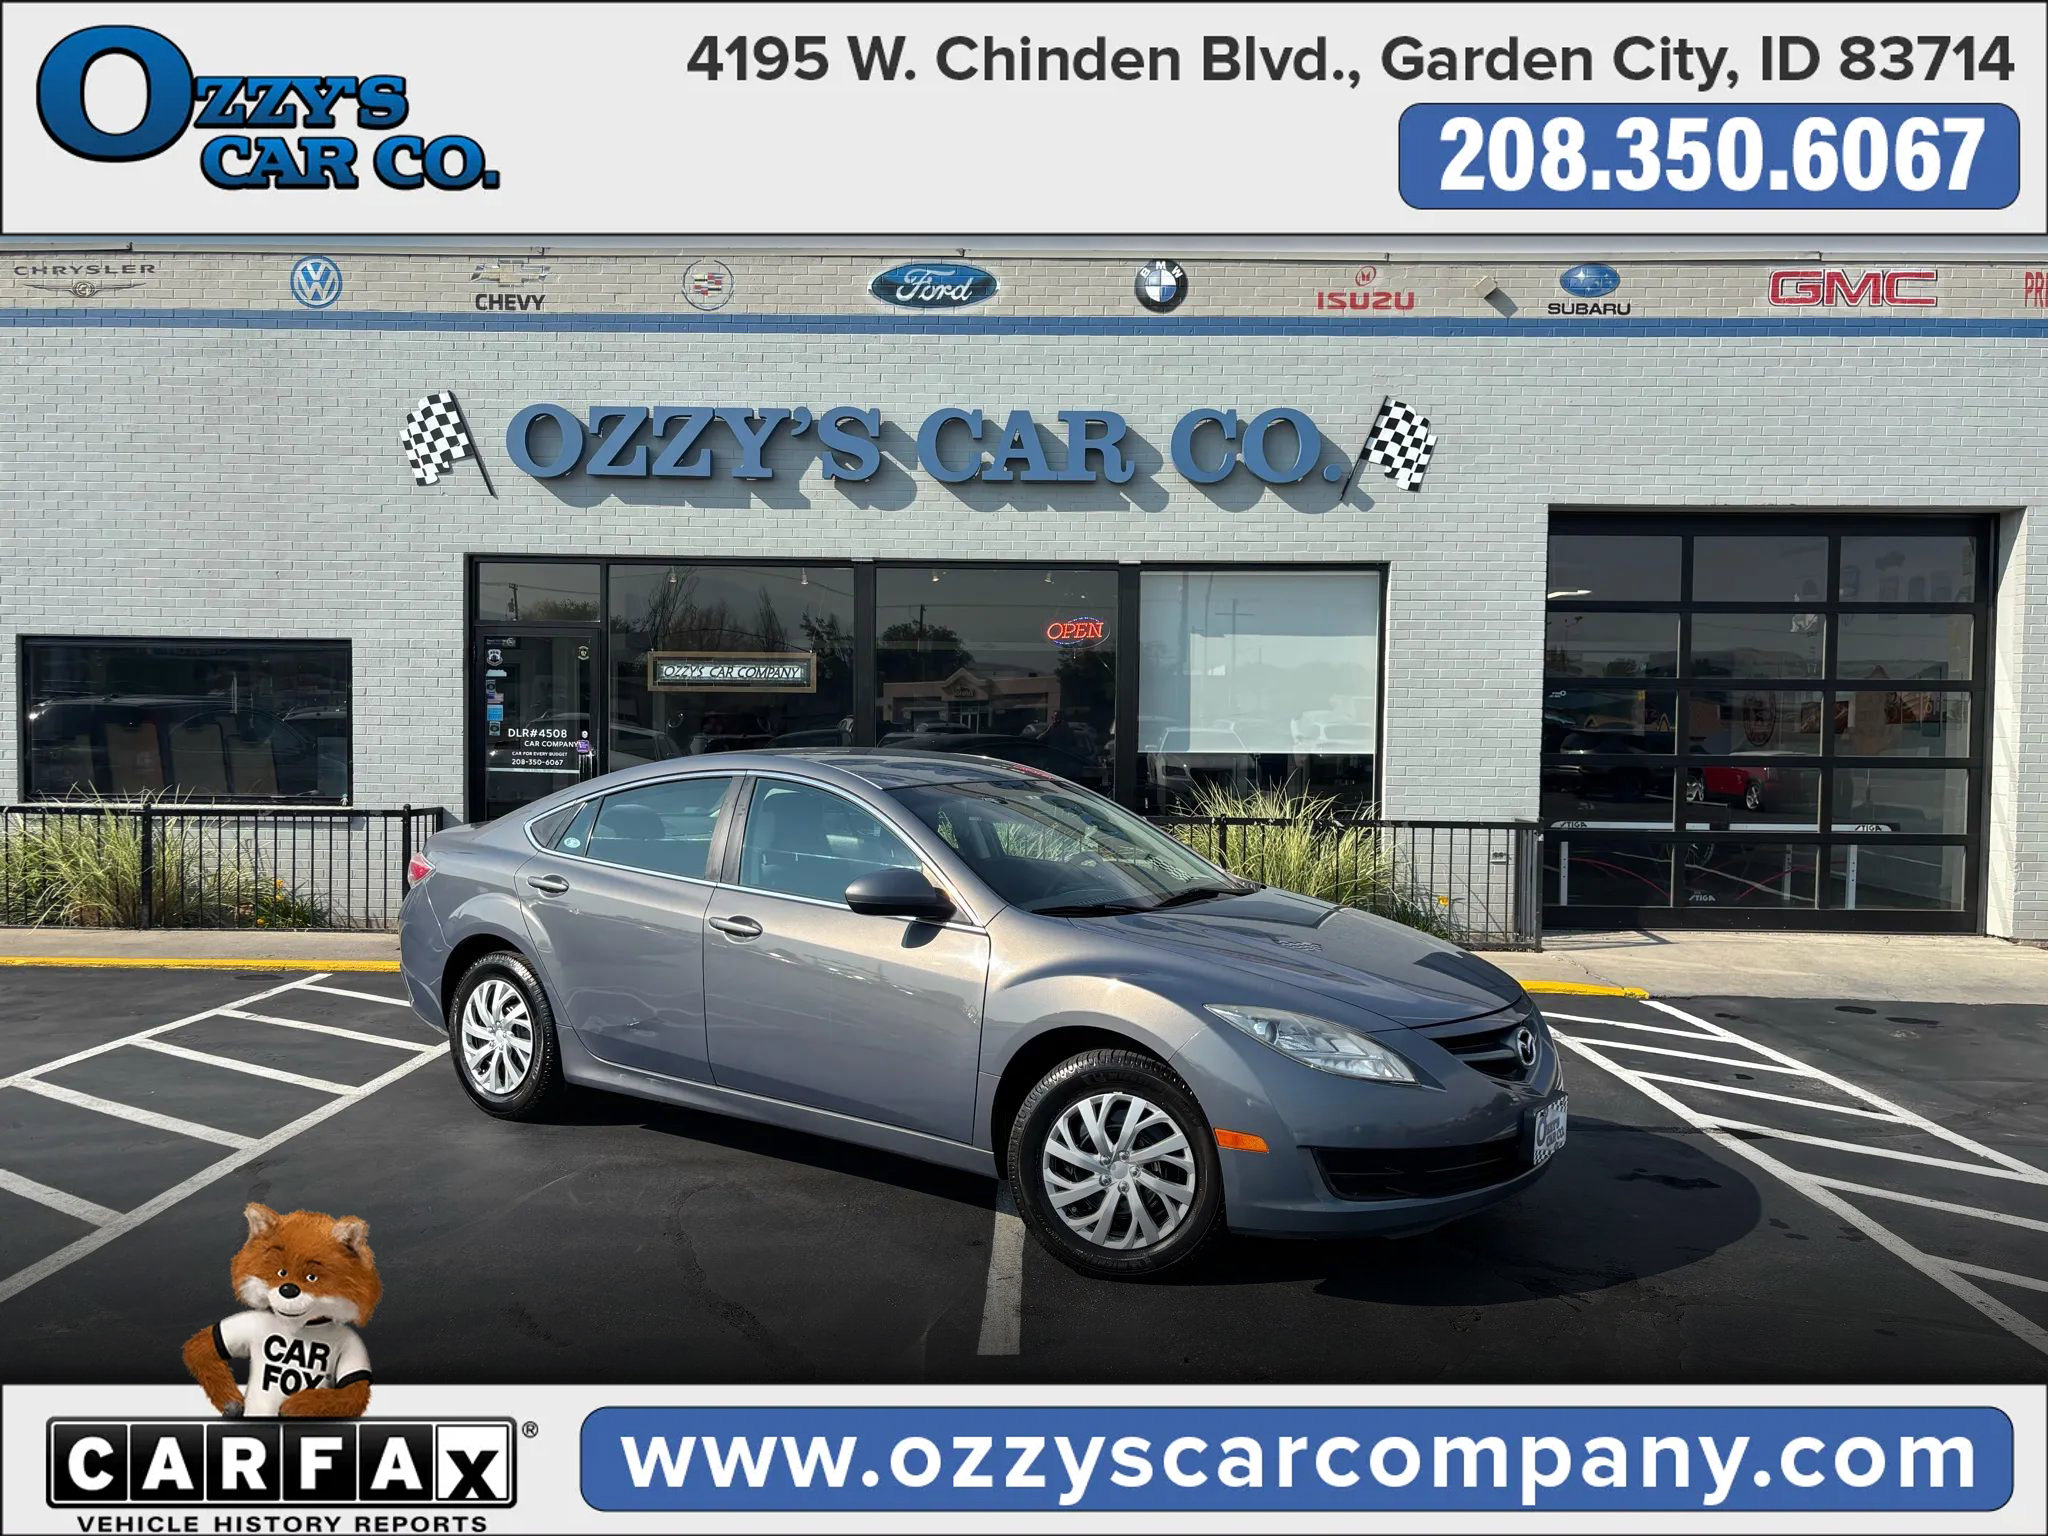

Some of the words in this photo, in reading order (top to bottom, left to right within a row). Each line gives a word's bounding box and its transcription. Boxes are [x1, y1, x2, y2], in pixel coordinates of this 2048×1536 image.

[14, 265, 156, 276] CHRYSLER
[1140, 260, 1183, 279] BMW
[896, 268, 973, 301] Ford
[1768, 268, 1939, 308] GMC
[475, 293, 546, 311] CHEVY
[1317, 291, 1415, 311] ISUZU
[1547, 302, 1631, 316] SUBARU
[506, 403, 881, 482] OZZY'S
[917, 407, 1135, 484] CAR
[1171, 407, 1342, 484] CO.
[1047, 622, 1104, 640] OPEN
[664, 665, 703, 678] OZZY'S
[710, 666, 733, 678] CAR
[738, 667, 799, 679] COMPANY
[508, 728, 568, 739] DLR#4508
[524, 740, 540, 748] CAR
[542, 740, 580, 748] COMPANY
[512, 758, 564, 766] 208-350-6067
